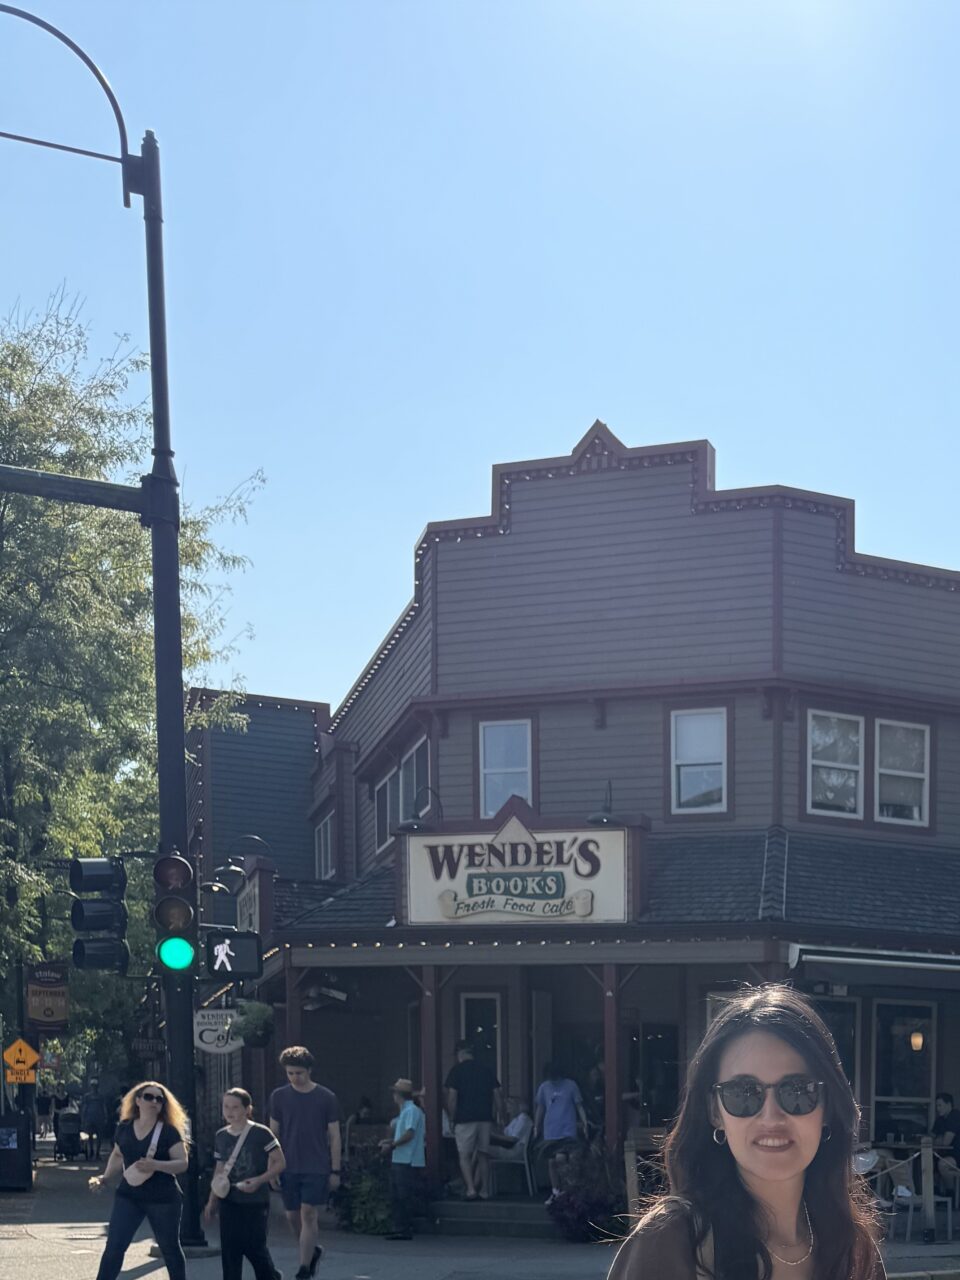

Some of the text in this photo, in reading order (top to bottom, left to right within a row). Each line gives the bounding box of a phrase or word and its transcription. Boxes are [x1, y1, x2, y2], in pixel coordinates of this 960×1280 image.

[424, 836, 601, 881] WENDEL'S
[472, 876, 558, 896] BOOKS
[455, 897, 496, 915] Fresh
[503, 897, 535, 913] Food
